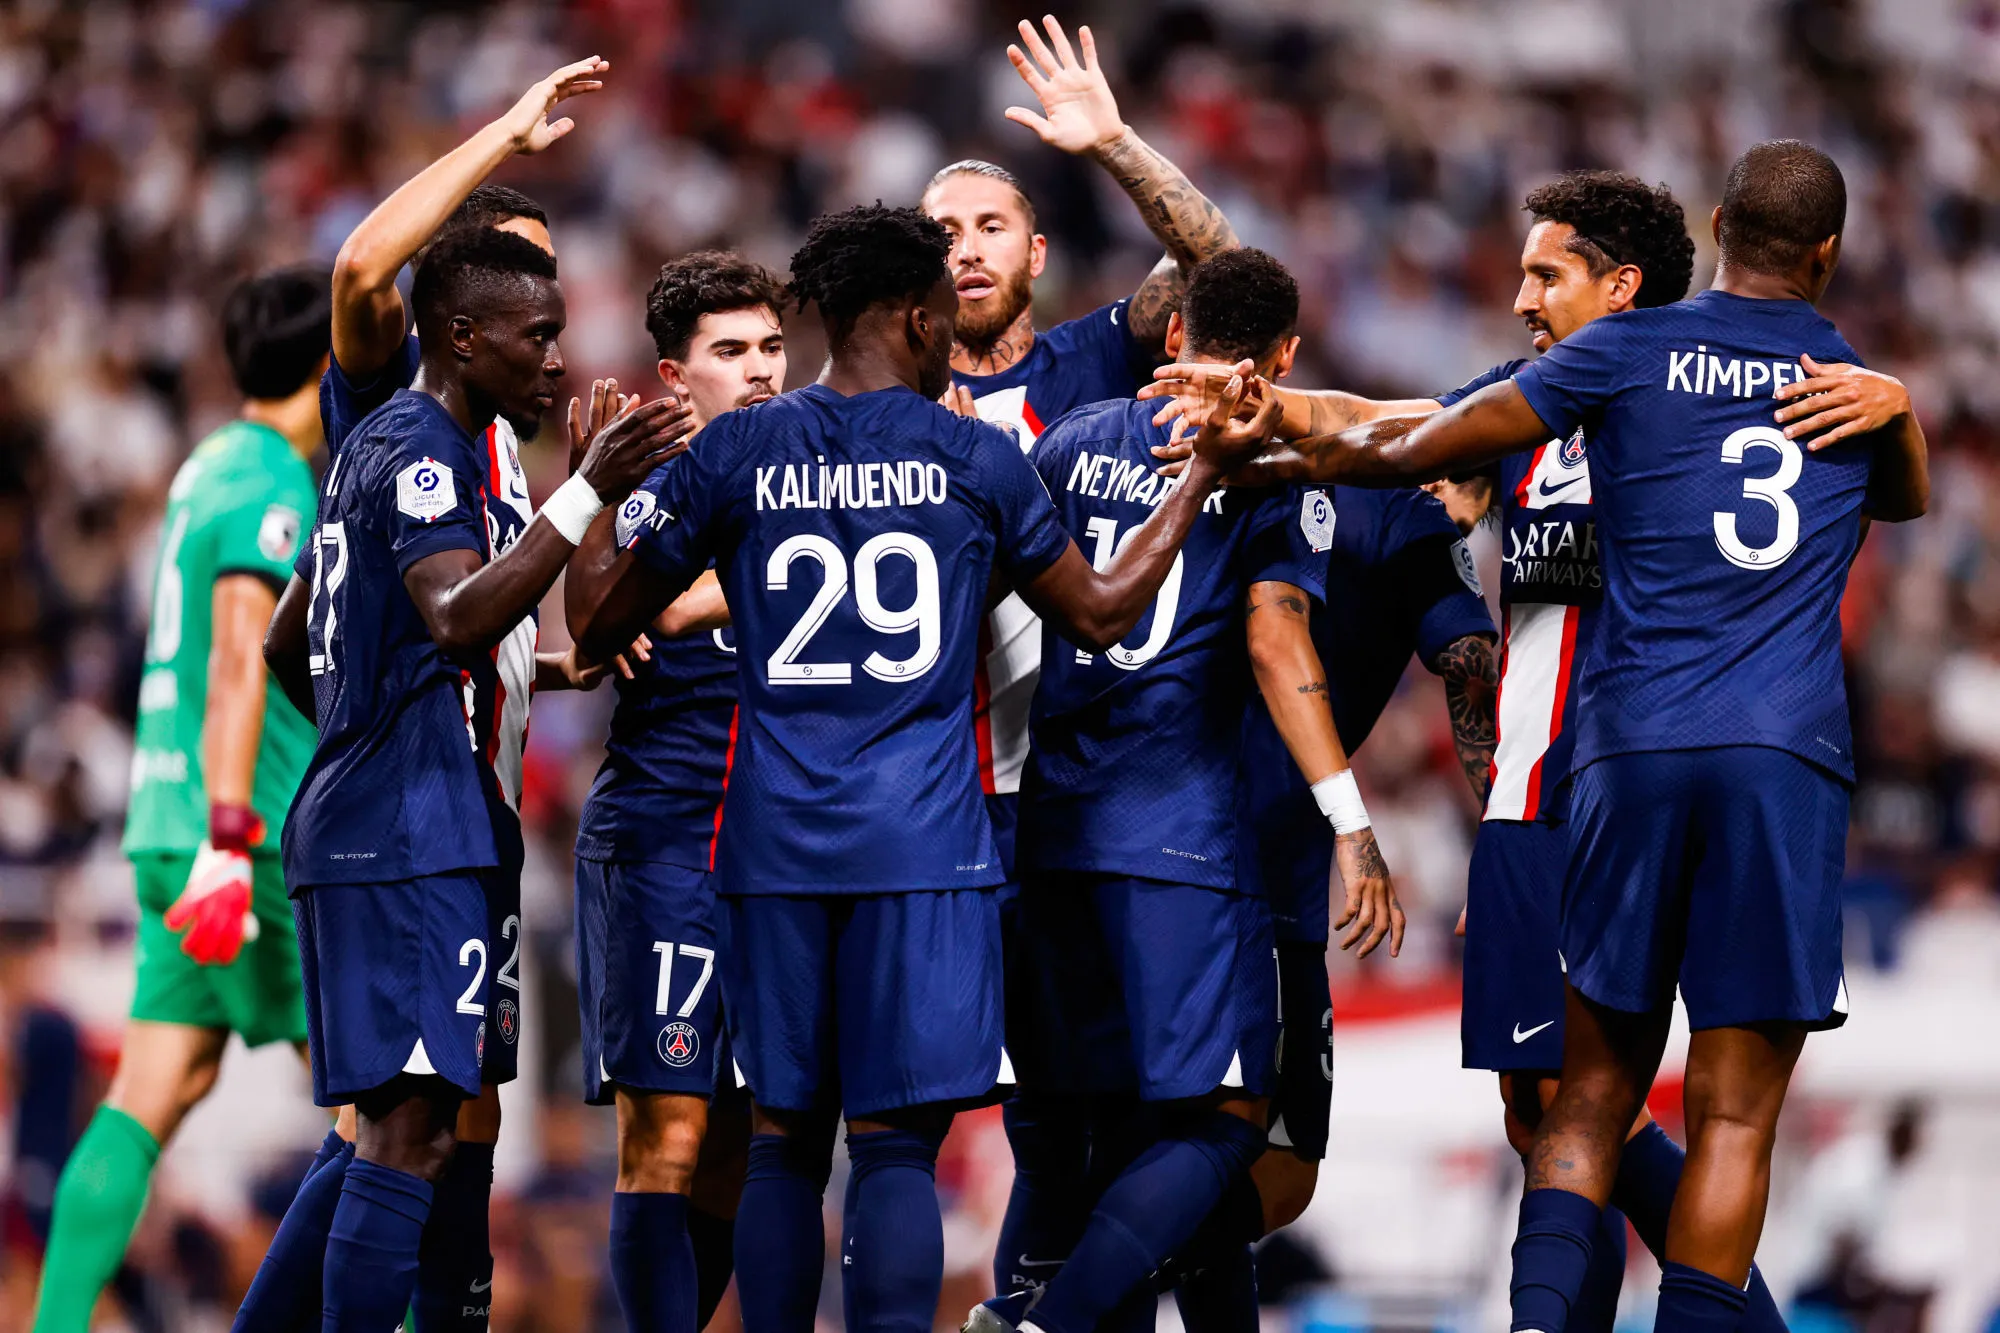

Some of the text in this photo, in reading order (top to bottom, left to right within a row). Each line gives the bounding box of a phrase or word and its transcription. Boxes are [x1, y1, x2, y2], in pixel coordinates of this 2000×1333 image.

[1713, 426, 1803, 570] 3
[767, 532, 941, 685] 29
[1513, 561, 1602, 588] AIRWAYS
[652, 941, 715, 1018] 17
[665, 1024, 694, 1037] PARIS
